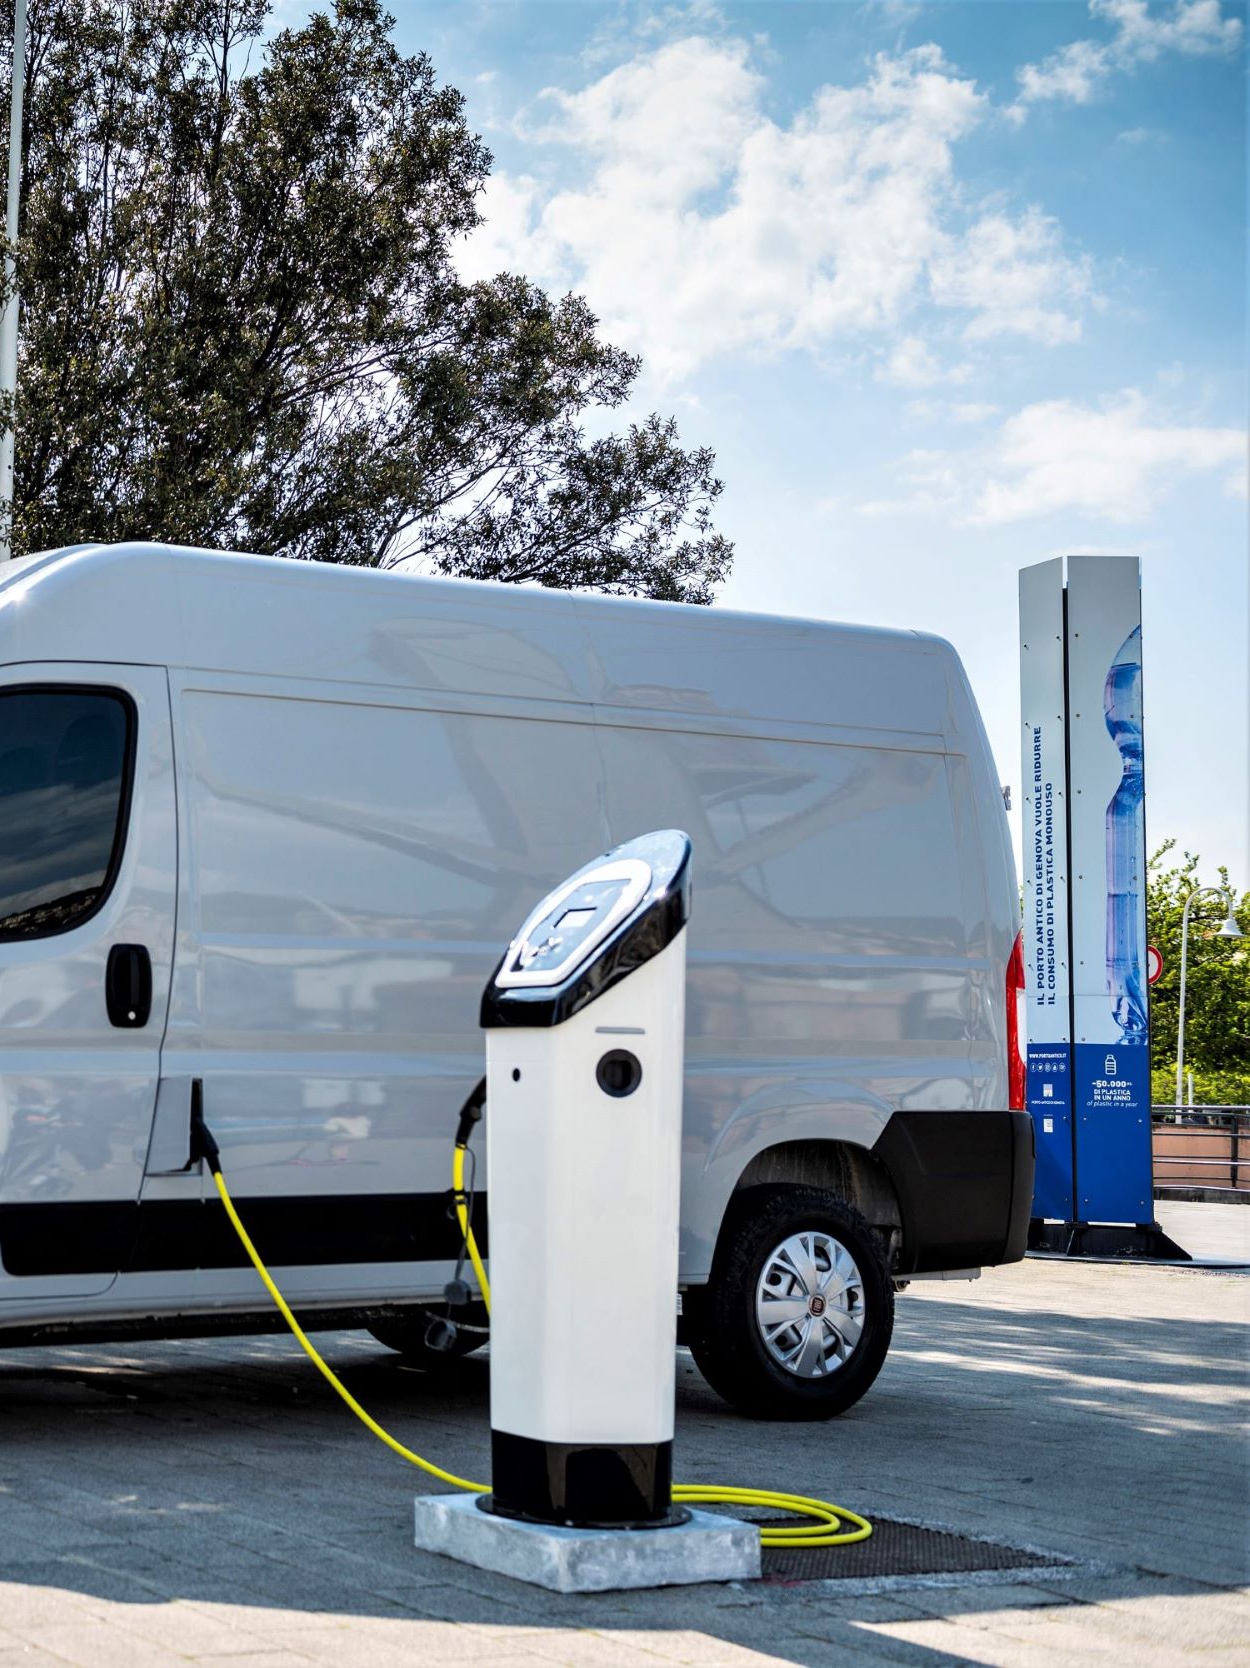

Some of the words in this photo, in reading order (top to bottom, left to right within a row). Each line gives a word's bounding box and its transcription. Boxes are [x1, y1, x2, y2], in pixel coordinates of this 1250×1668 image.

[1045, 783, 1053, 845] MONOUSO
[1046, 848, 1054, 909] PLASTICA
[1036, 883, 1043, 895] DI
[1047, 913, 1054, 925] DI
[1047, 929, 1055, 990] CONSUMO
[1037, 993, 1044, 1005] IL
[1048, 993, 1056, 1005] IL
